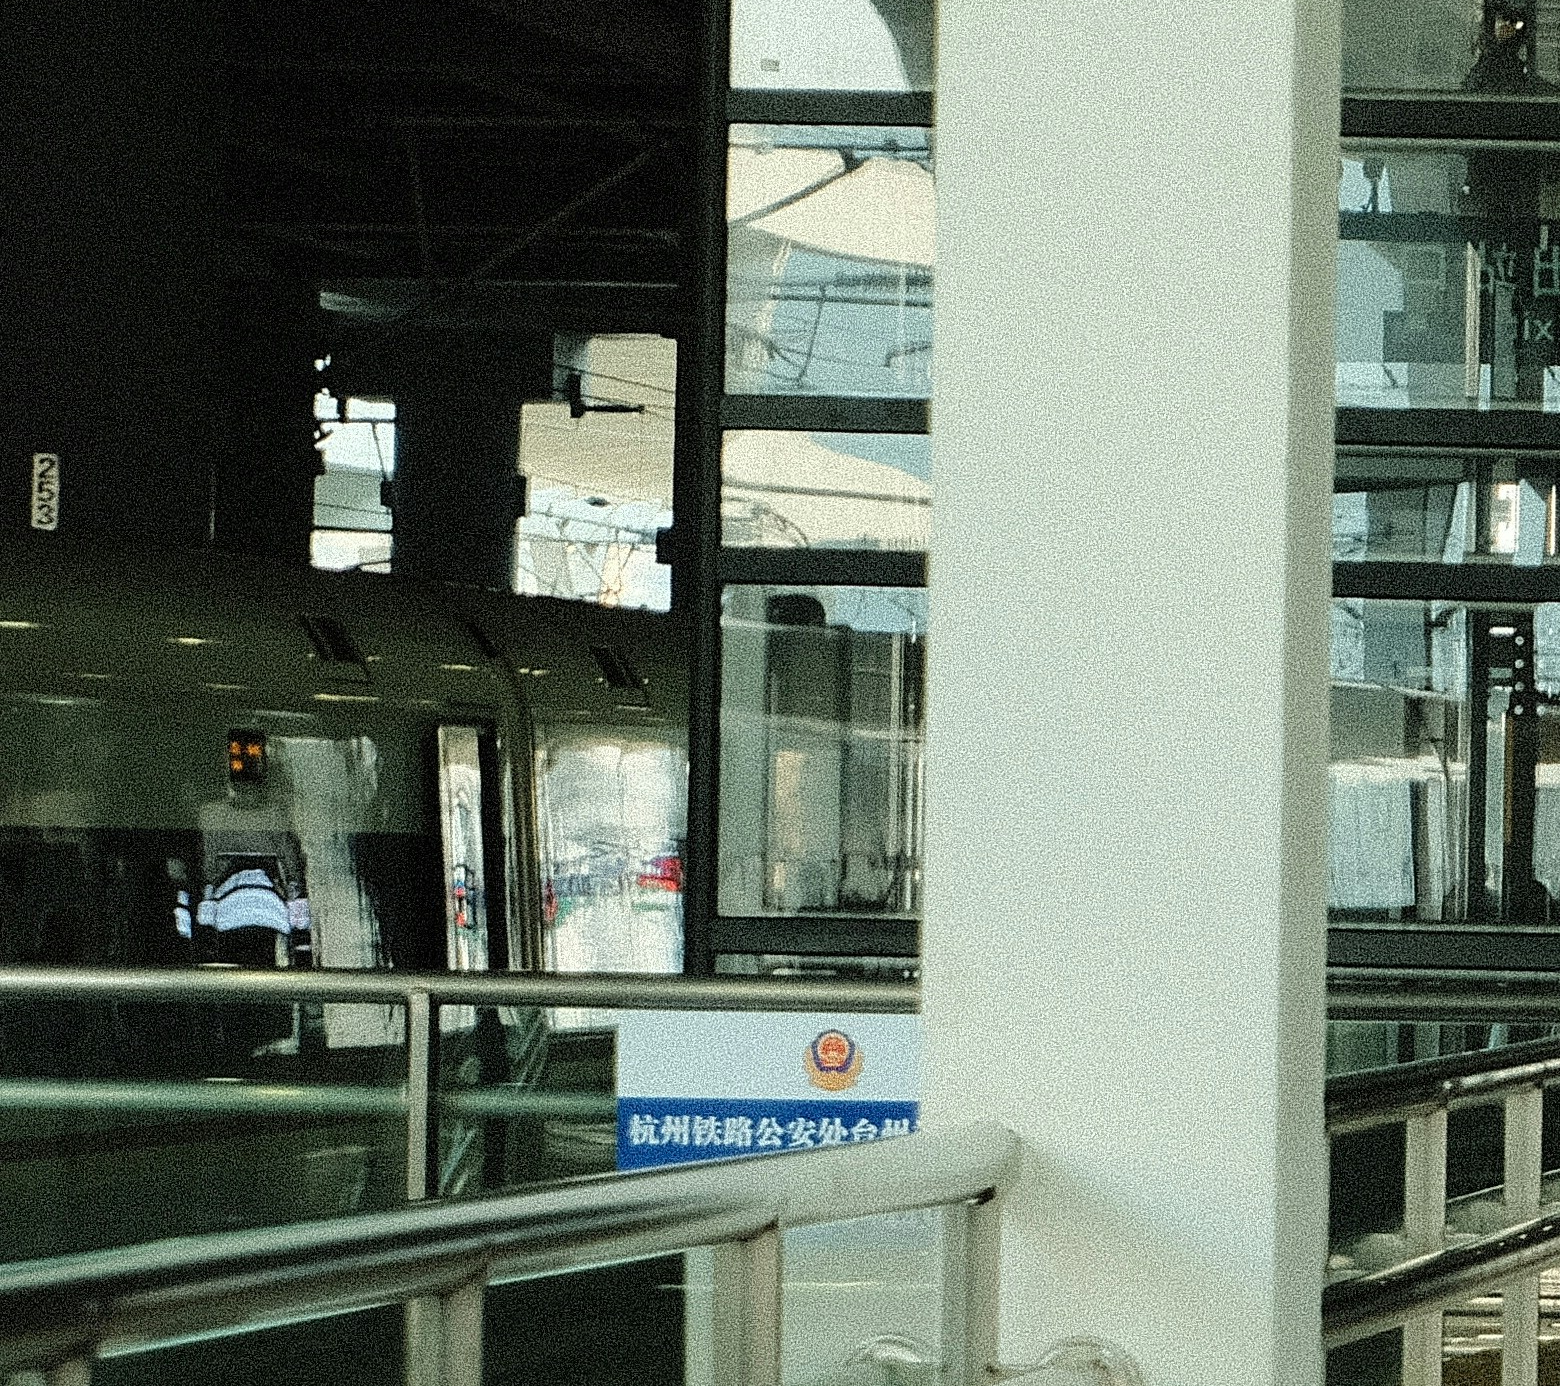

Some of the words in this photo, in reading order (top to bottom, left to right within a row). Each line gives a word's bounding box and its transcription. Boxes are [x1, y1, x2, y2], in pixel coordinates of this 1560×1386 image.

[36, 456, 57, 526] 253
[628, 1113, 921, 1149] 杭州铁路公安处台州
